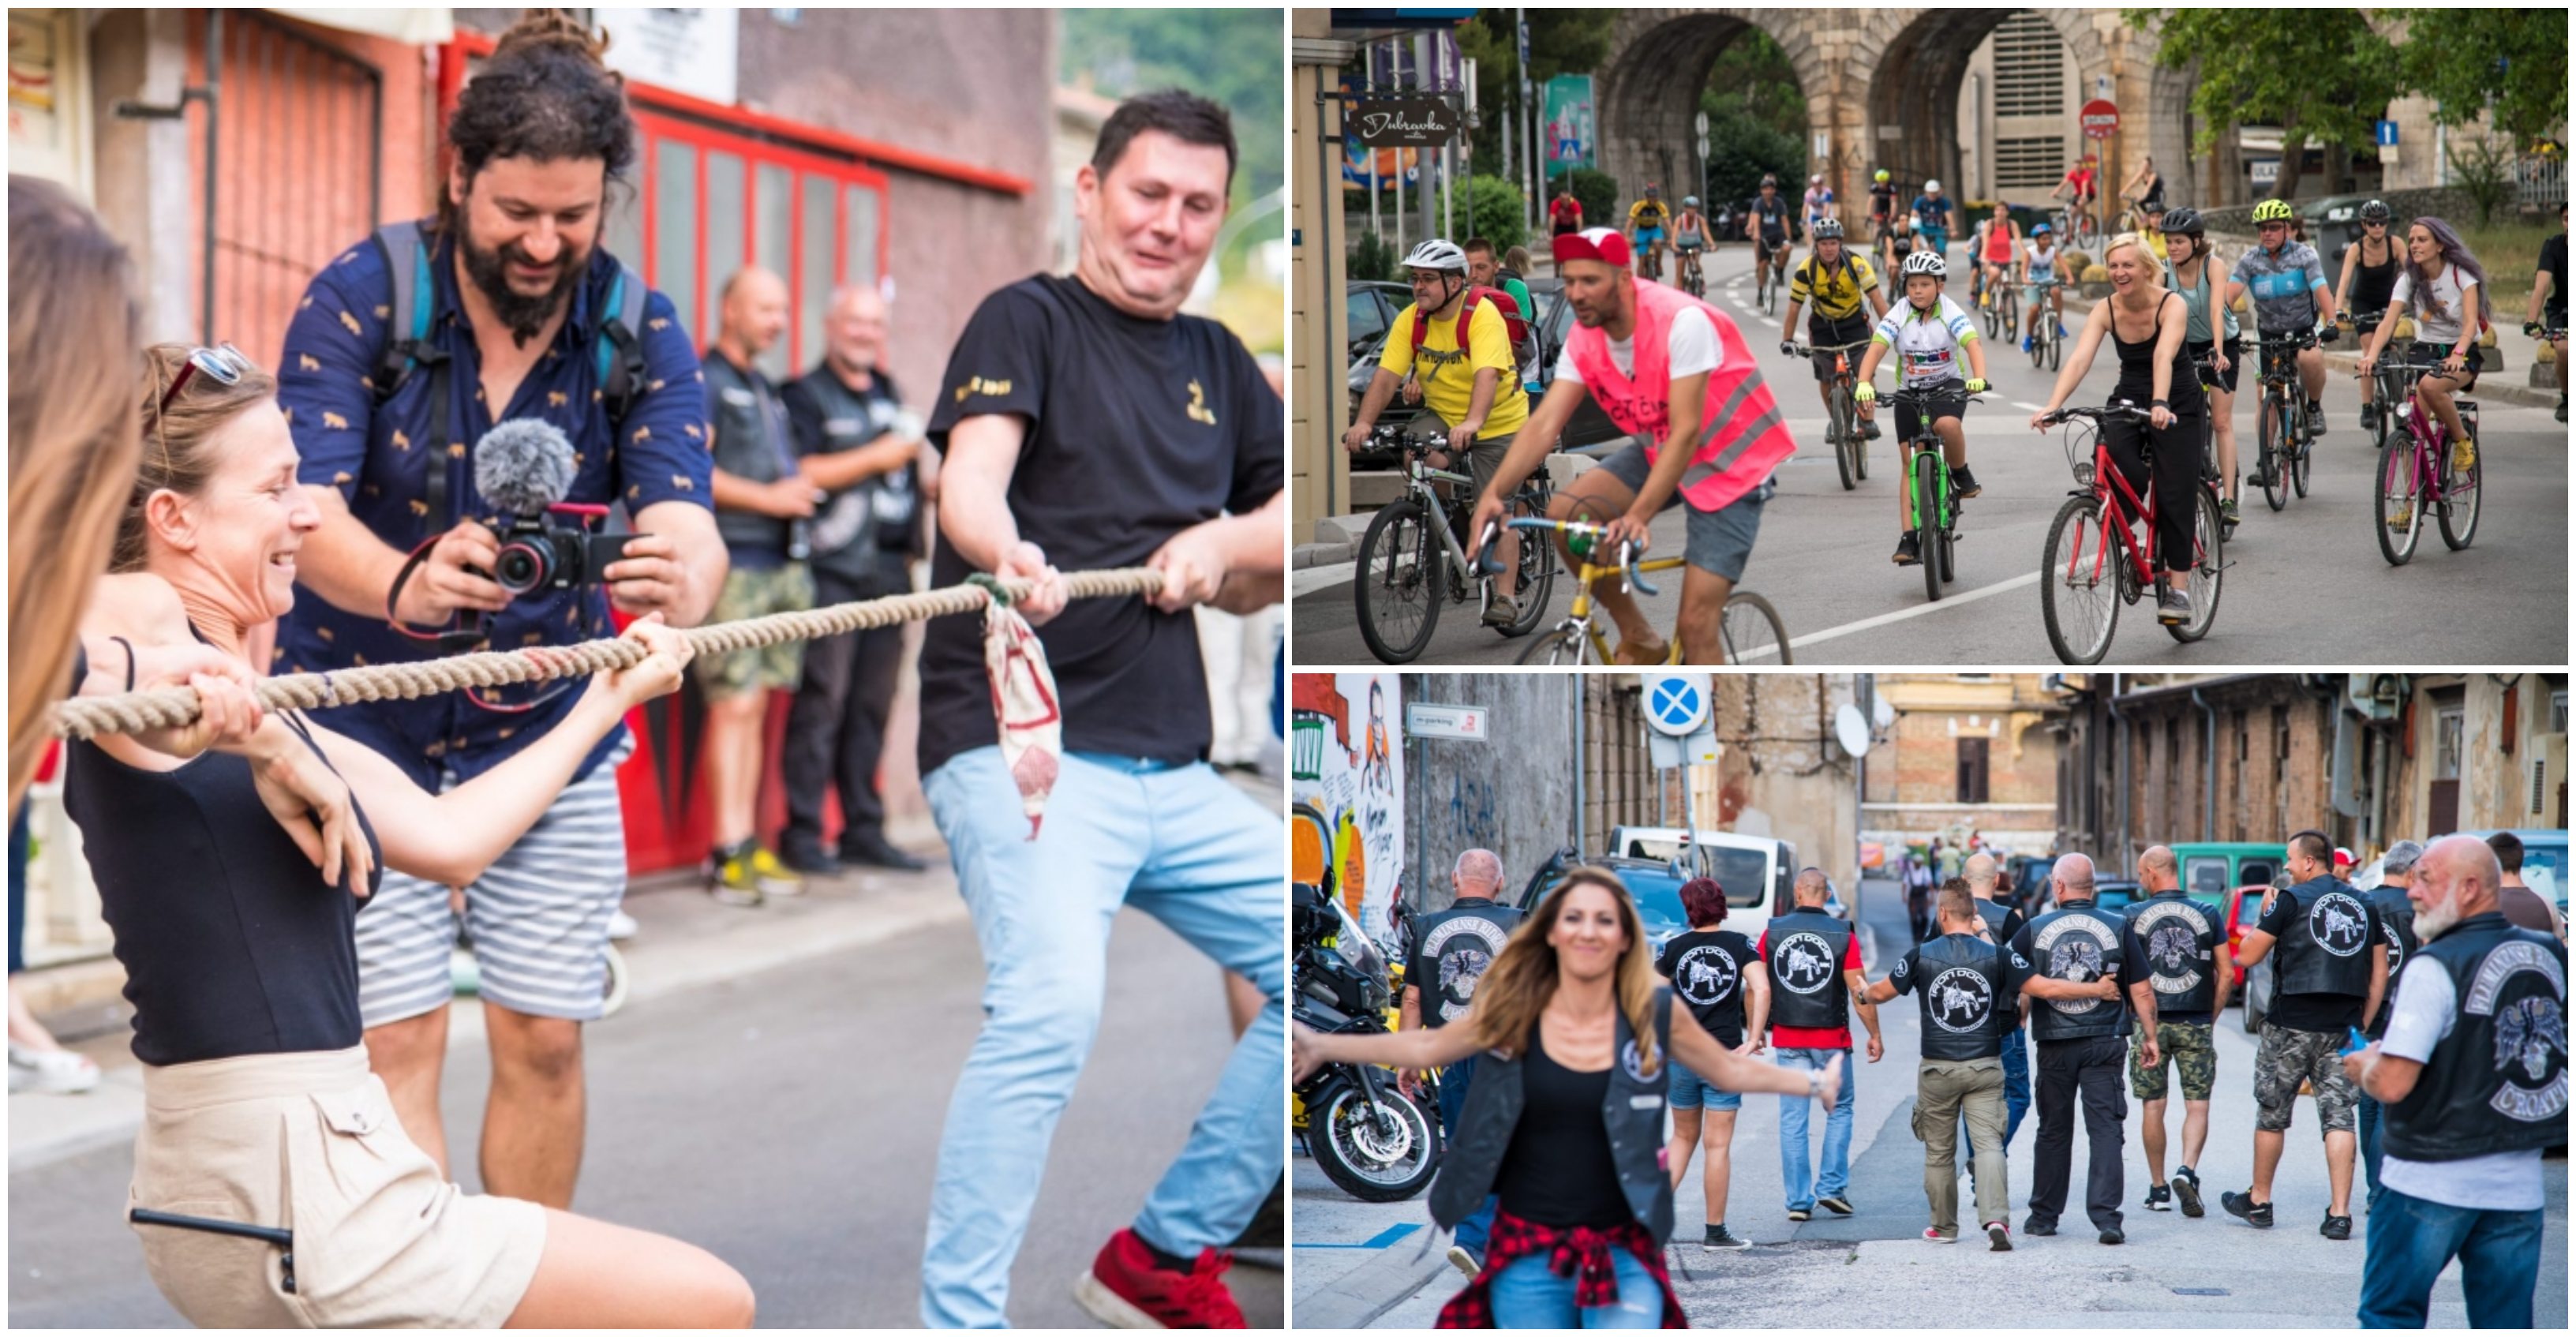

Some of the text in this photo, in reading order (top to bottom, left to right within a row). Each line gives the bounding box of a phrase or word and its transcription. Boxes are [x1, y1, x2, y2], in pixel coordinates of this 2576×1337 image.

[1362, 110, 1447, 139] Dubravka
[2312, 895, 2336, 918] IRON
[1777, 934, 1803, 957] IRON
[1679, 948, 1704, 971] IRON
[1930, 971, 1955, 997] IRON
[2151, 972, 2200, 992] CROATIA
